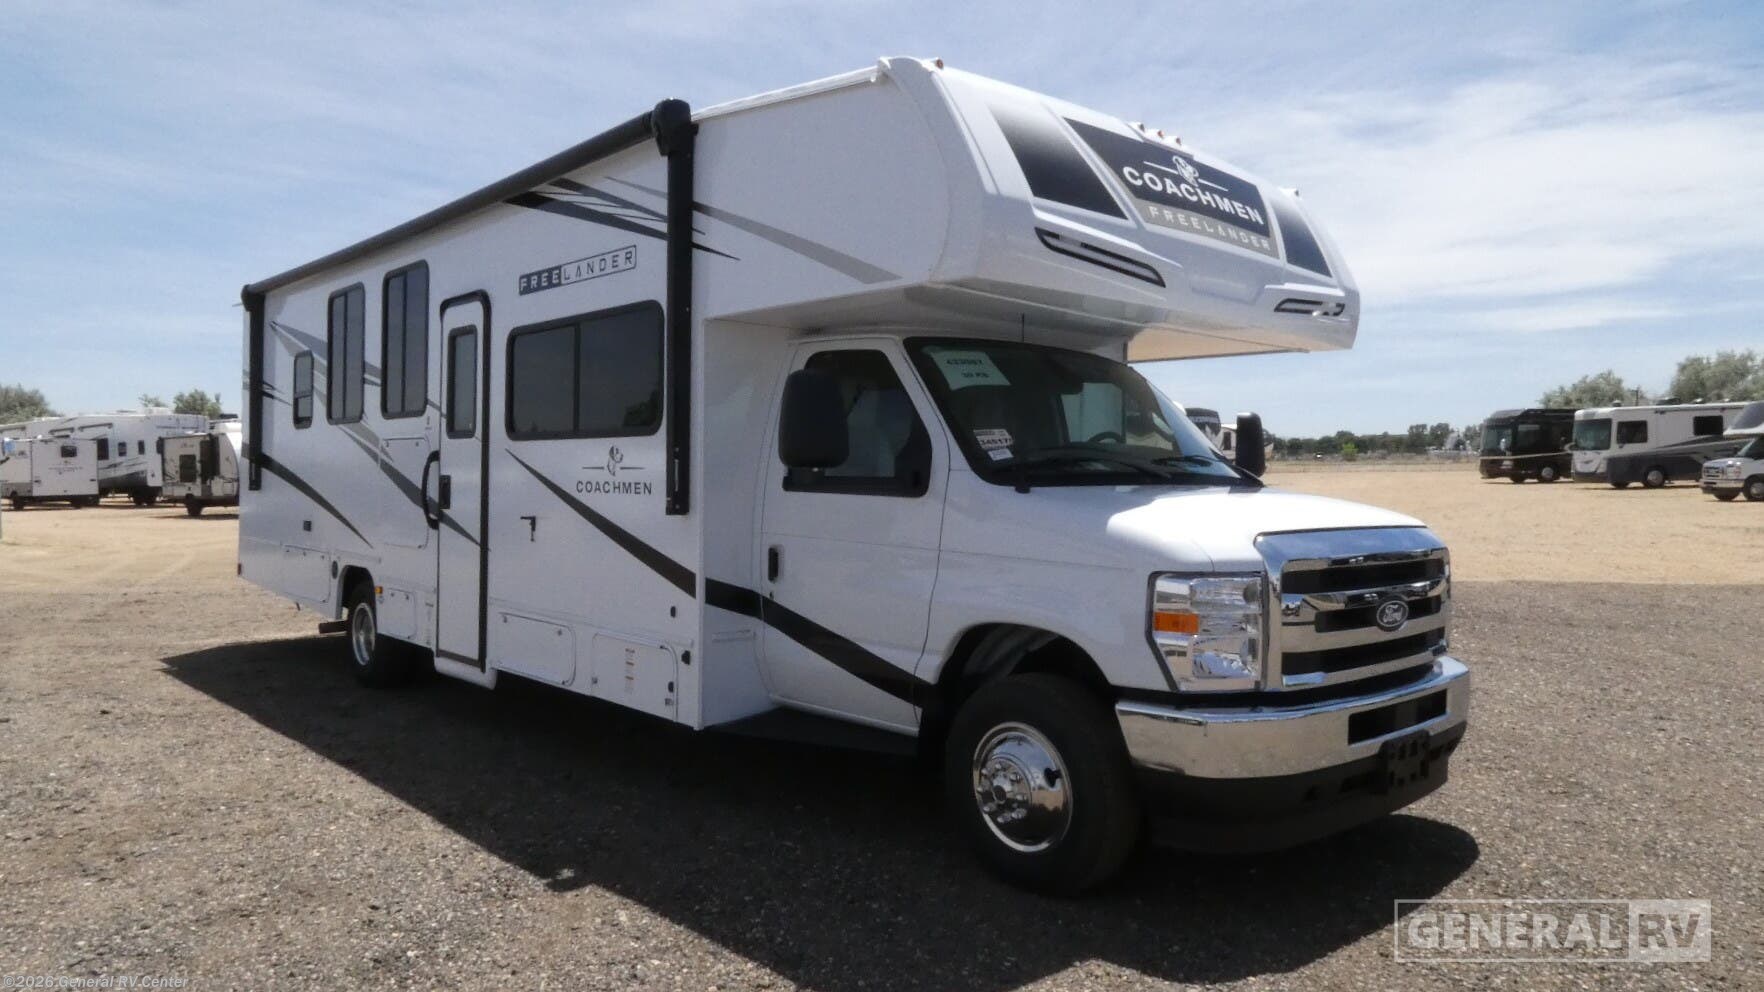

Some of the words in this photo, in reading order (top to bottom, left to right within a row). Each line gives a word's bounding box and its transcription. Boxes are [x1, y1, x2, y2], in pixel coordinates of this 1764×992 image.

[1122, 166, 1264, 225] COACHMEN
[1149, 205, 1271, 251] FREELANDER
[519, 250, 634, 292] FREELANDER
[576, 480, 652, 496] COACHMEN
